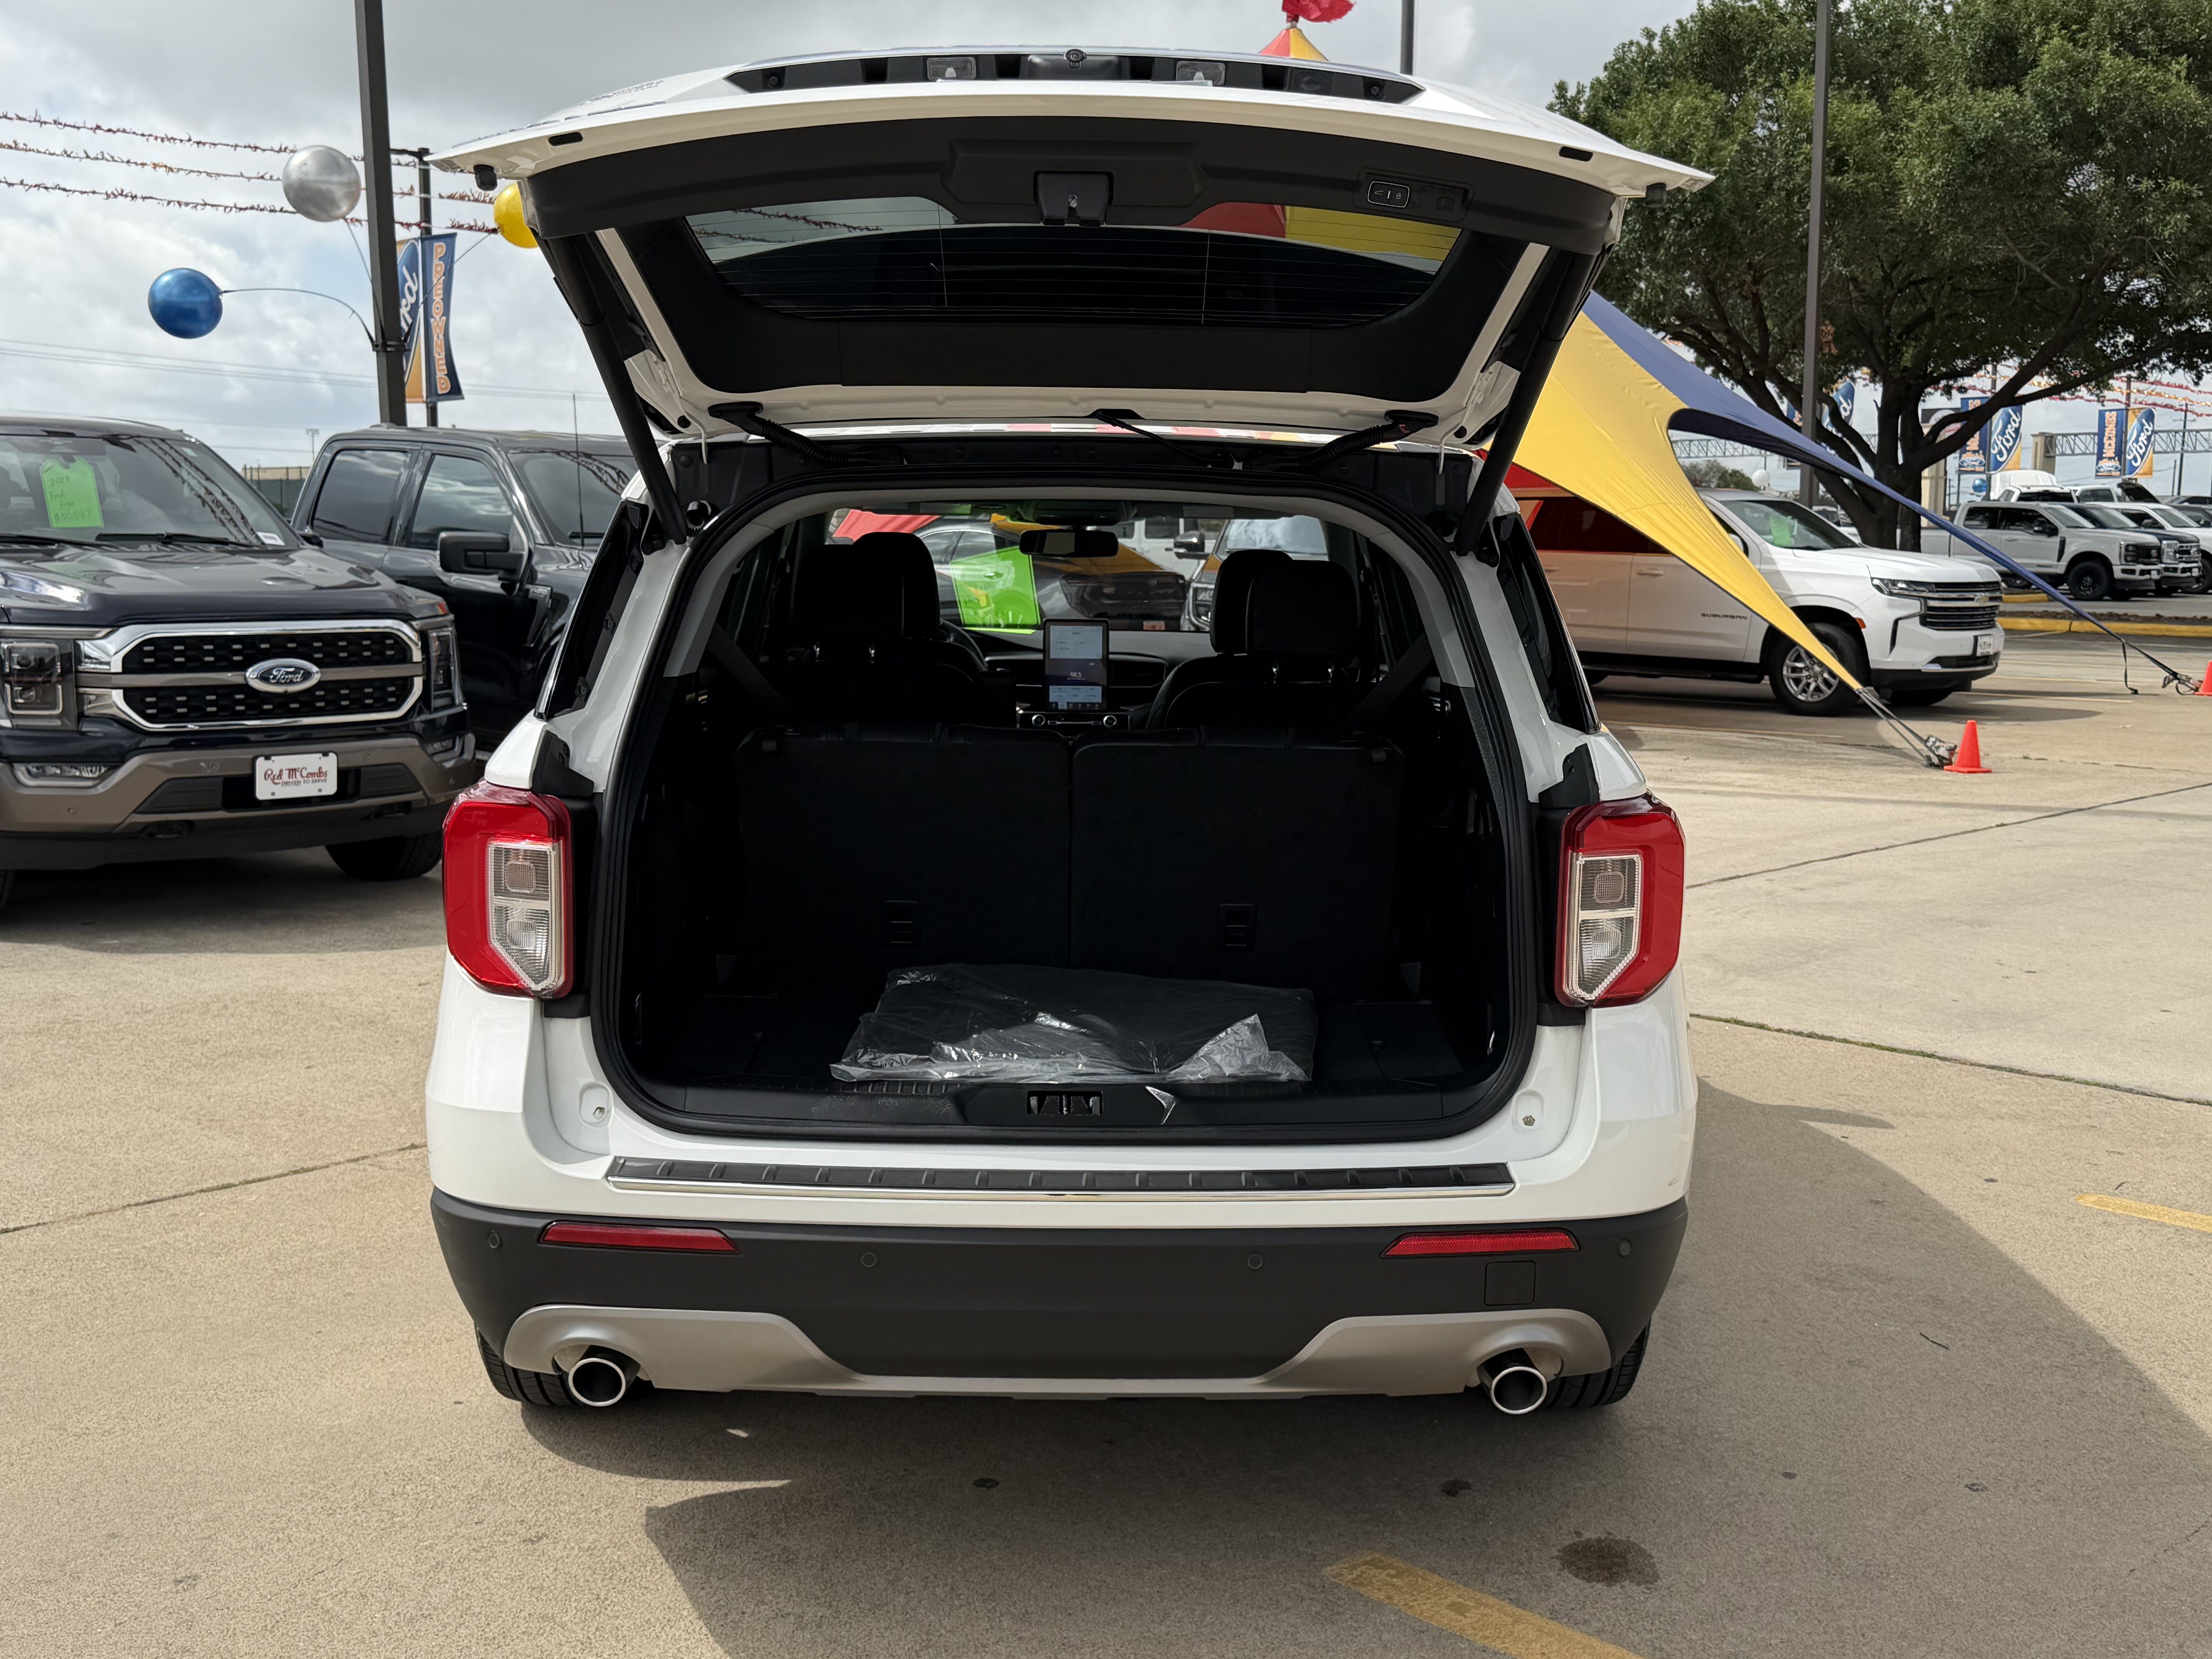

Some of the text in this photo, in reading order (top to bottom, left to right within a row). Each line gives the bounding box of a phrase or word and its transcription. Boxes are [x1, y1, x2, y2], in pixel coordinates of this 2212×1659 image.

[1991, 408, 2021, 462] Ford
[2126, 418, 2153, 467] Ford
[269, 667, 303, 684] Ford
[264, 766, 328, 785] Red McCombs
